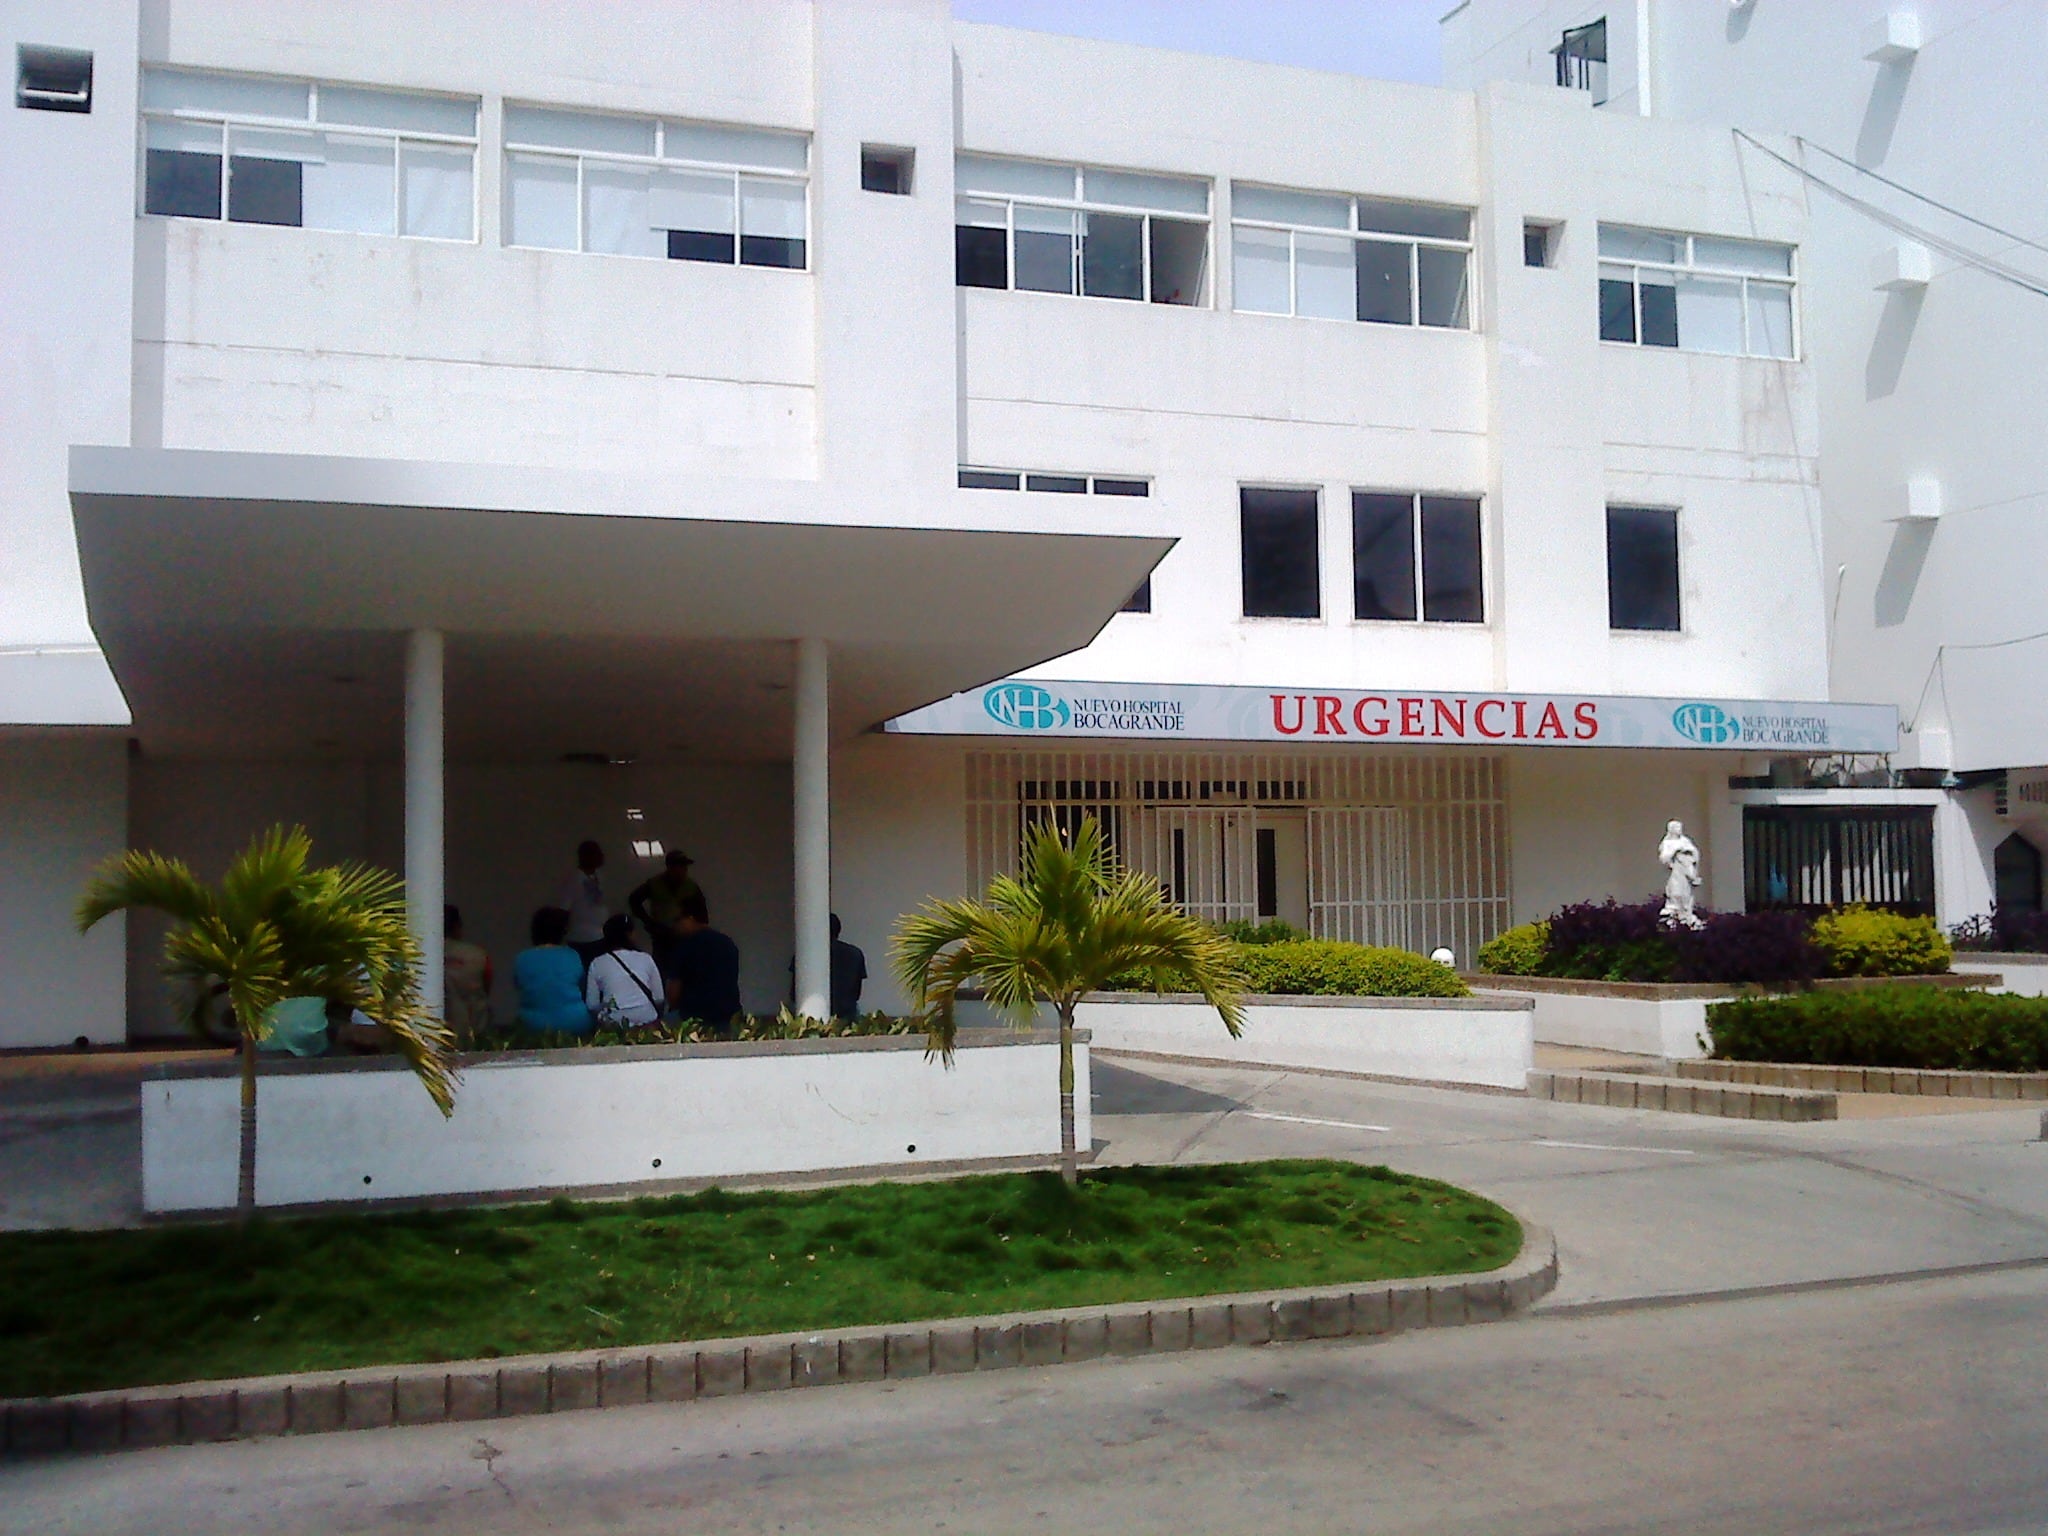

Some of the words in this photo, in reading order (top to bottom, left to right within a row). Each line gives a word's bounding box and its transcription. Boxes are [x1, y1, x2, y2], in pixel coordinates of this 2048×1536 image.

[1074, 699, 1121, 713] NUEVO
[1123, 700, 1184, 714] HOSPITAL
[1074, 714, 1185, 730] BOCAGRANDE
[1270, 695, 1598, 739] URGENCIAS
[1743, 716, 1779, 729] NUEVO
[1781, 717, 1828, 730] HOSPITAL
[1743, 729, 1829, 744] BOCAGRANDE
